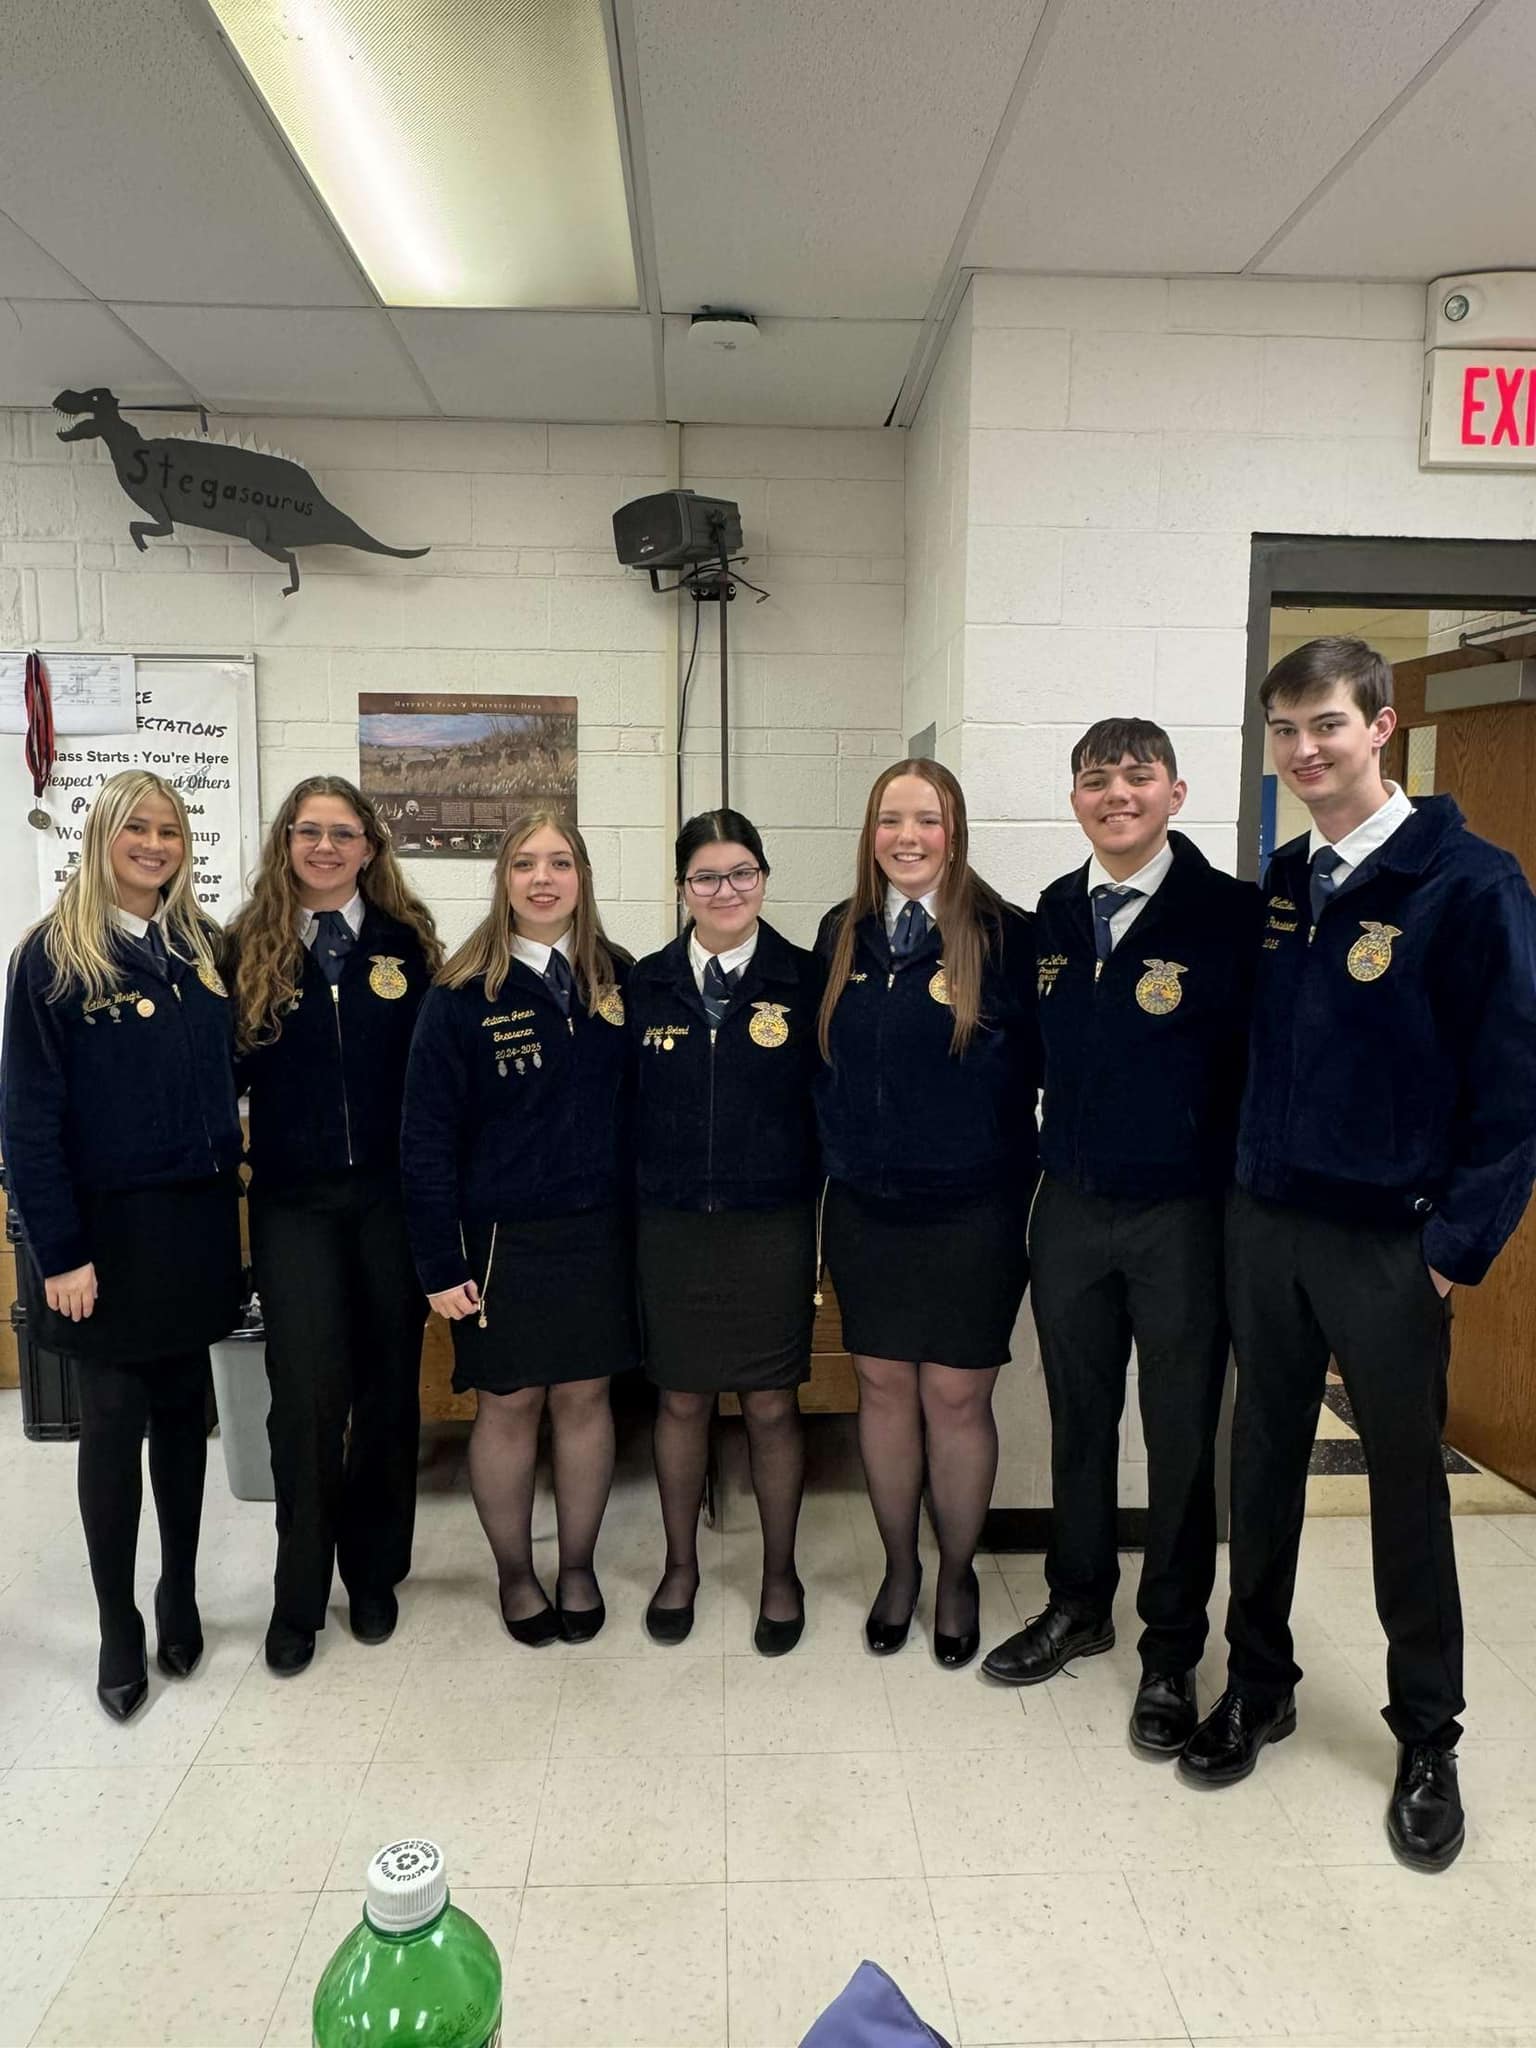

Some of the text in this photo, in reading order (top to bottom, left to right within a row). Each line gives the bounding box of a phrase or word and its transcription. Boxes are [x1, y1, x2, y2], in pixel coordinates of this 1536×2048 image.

[1461, 367, 1536, 446] EXI
[126, 450, 314, 517] Stegasourus
[136, 716, 228, 738] ECTATIONS
[54, 750, 83, 762] lass
[86, 750, 130, 763] Starts
[142, 751, 190, 764] You're
[194, 752, 229, 764] Here
[186, 775, 230, 789] Others
